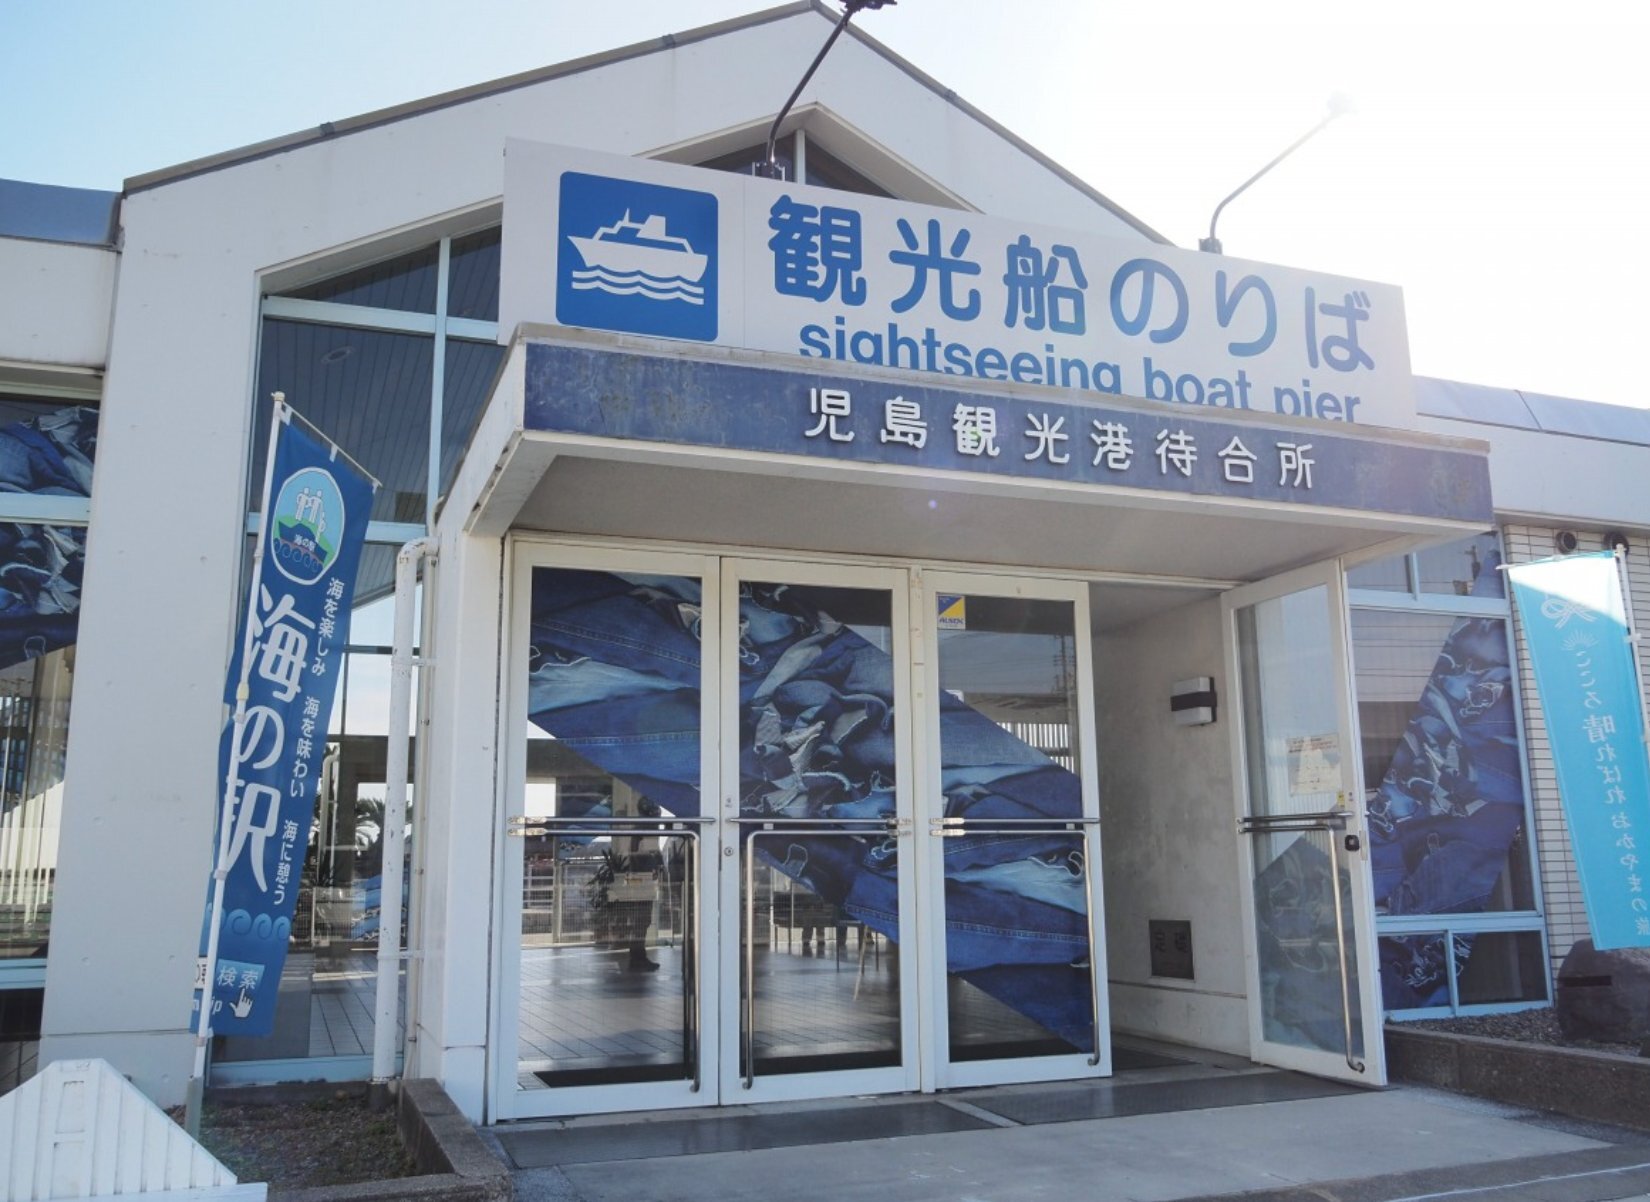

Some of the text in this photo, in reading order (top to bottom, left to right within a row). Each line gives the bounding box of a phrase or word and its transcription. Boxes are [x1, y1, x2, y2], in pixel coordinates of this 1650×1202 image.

[769, 195, 1375, 372] 観光船のりば
[800, 316, 1361, 423] sightseeing boat pier
[804, 387, 1316, 490] 児島観光港待合所
[273, 577, 345, 905] 海を楽しみ 海を味わい 海に憩う
[217, 965, 259, 990] 検索
